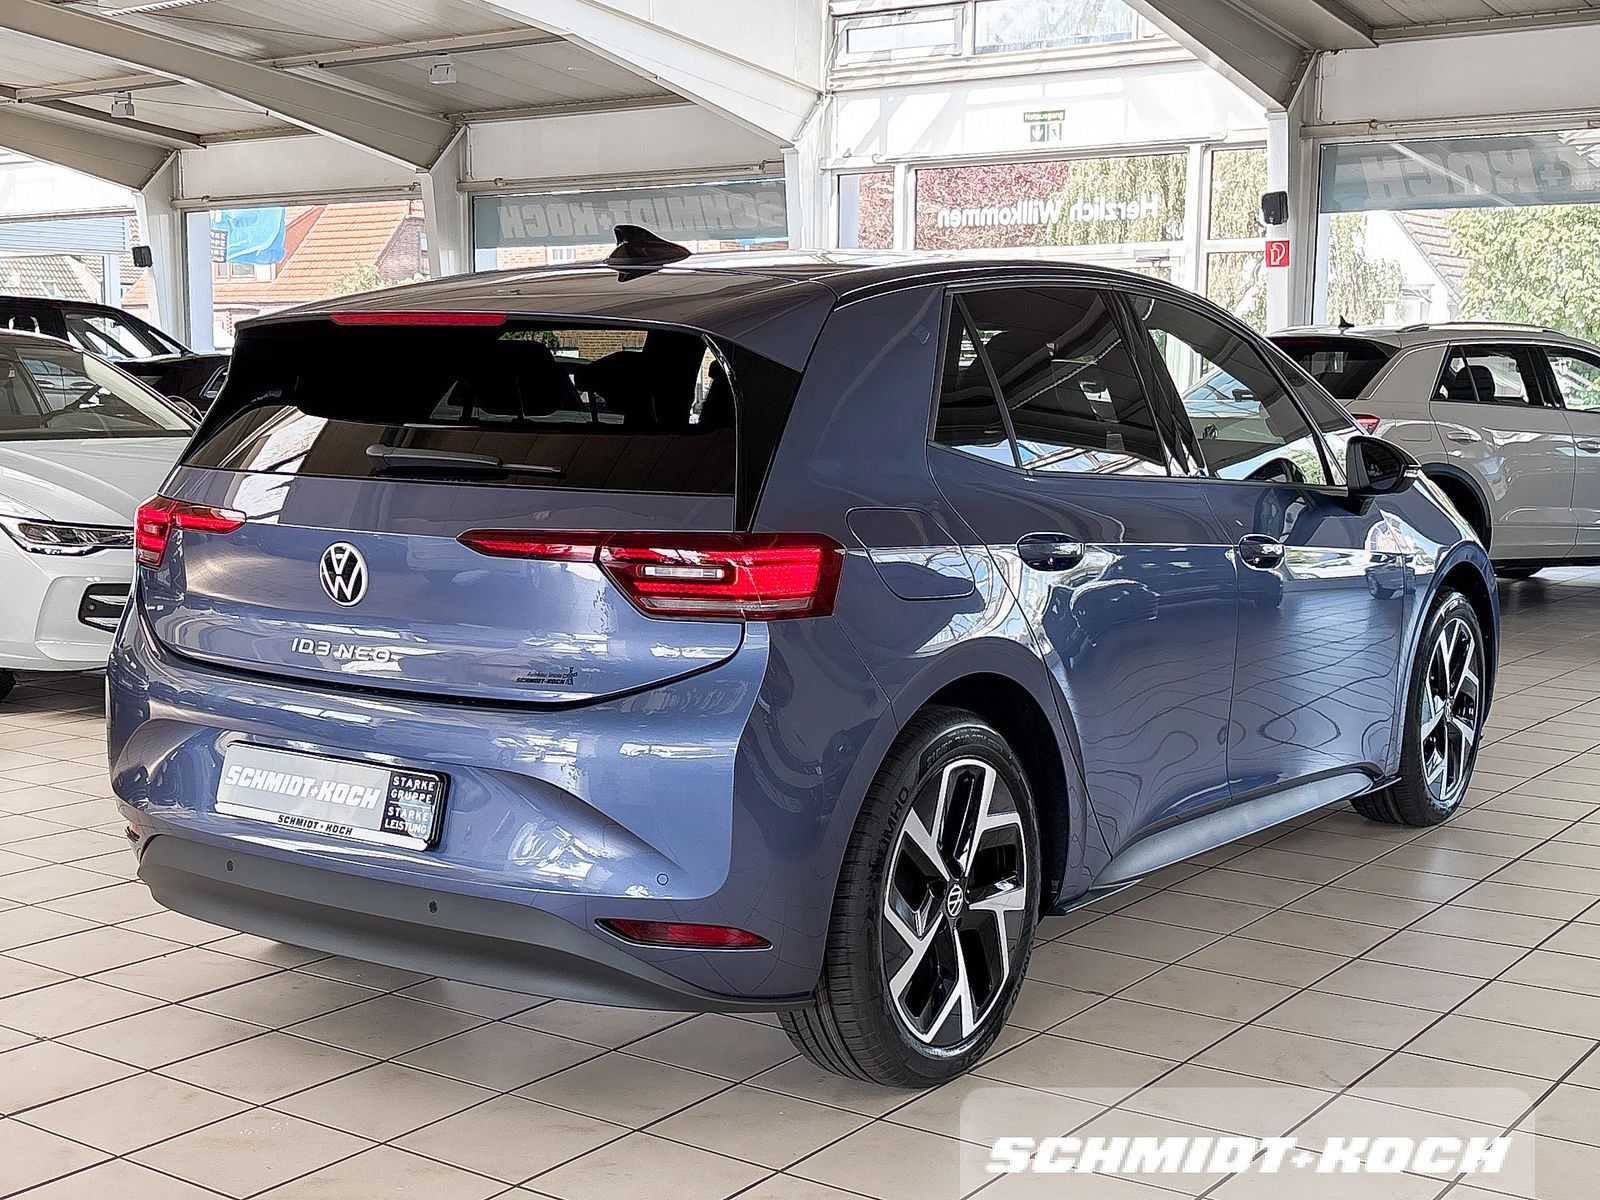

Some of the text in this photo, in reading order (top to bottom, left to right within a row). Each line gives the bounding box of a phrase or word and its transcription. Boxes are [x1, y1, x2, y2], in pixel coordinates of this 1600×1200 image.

[392, 776, 436, 792] STARKE
[390, 789, 433, 804] GRUPPE
[387, 807, 429, 822] STARKE
[384, 820, 427, 834] LEISTUNG
